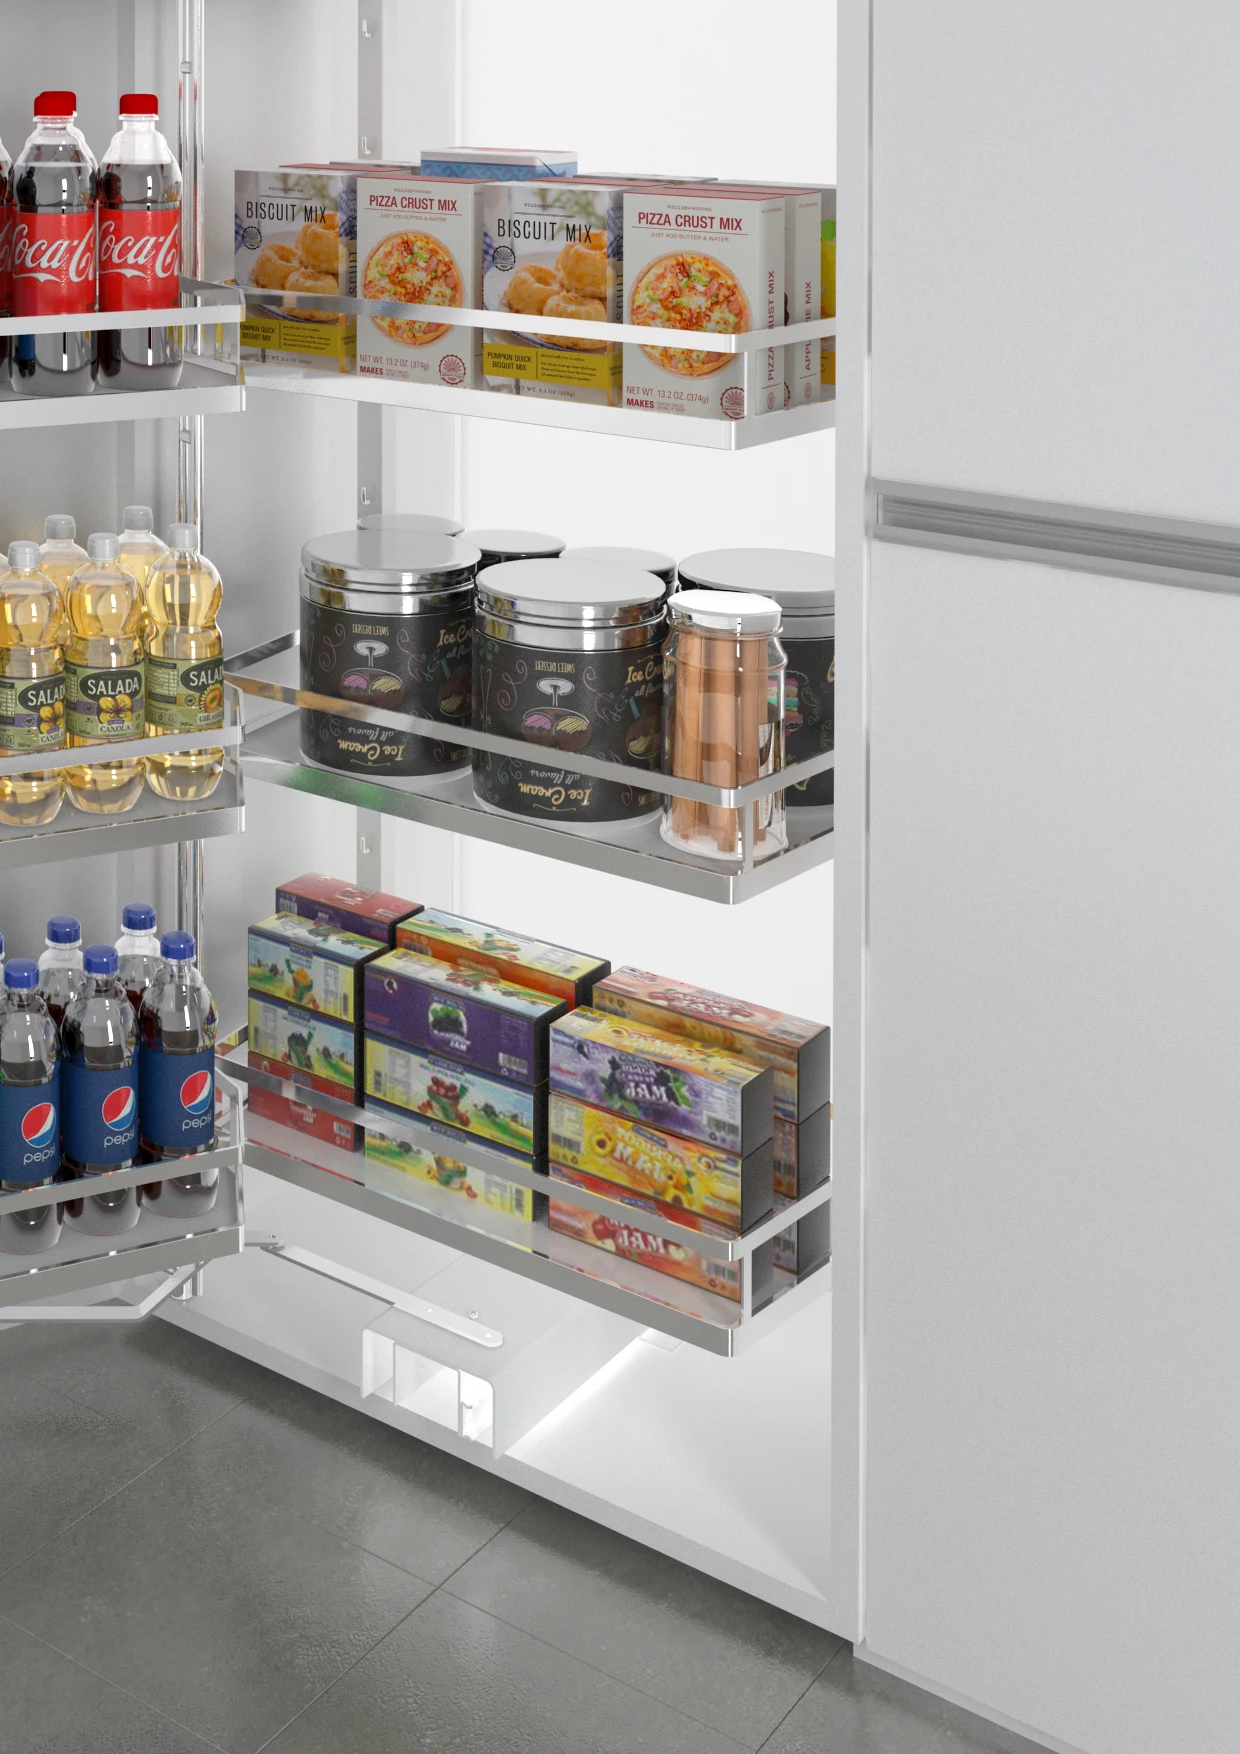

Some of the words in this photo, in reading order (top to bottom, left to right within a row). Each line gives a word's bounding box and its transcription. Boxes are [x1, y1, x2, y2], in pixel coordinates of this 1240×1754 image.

[369, 194, 397, 207] PIZZA
[400, 196, 434, 210] CRUST
[438, 199, 457, 212] MIX
[246, 201, 297, 222] BISCUIT
[304, 205, 327, 224] MIX
[638, 212, 671, 226] PIZZA
[675, 214, 715, 229] CRUST
[719, 218, 743, 231] MIX
[497, 218, 557, 241] BISCUIT
[565, 223, 592, 244] MIX
[261, 326, 276, 334] QUICK
[360, 354, 371, 363] NET
[373, 356, 384, 364] WT.
[386, 357, 398, 366] 13.2
[411, 360, 429, 371] (374g)
[487, 352, 513, 361] PUMPKIN
[514, 355, 532, 363] QUICK
[492, 361, 514, 370] BISQUIT
[360, 366, 384, 375] MAKES
[626, 386, 640, 395] NET
[642, 387, 655, 397] WT.
[657, 389, 672, 399] 13.2
[686, 393, 709, 404] (374g)
[626, 398, 655, 409] MAKES
[372, 625, 390, 636] SWEET
[437, 629, 456, 647] Ice
[535, 660, 557, 672] DESSERT
[557, 662, 575, 673] SWEET
[190, 667, 223, 686] SALAD
[625, 666, 644, 685] Ice
[28, 682, 65, 706] SALAD
[87, 677, 140, 695] SALADA
[634, 683, 645, 697] all
[199, 711, 223, 723] GIRASSO
[100, 724, 131, 733] CANOLA
[348, 727, 380, 741] flavors
[380, 730, 394, 742] all
[337, 738, 381, 760] Cream
[382, 744, 407, 761] Ice
[530, 769, 565, 784] flavors
[565, 773, 580, 785] all
[518, 782, 566, 806] Cream
[567, 787, 593, 806] Ice
[626, 1082, 668, 1102] JAM
[182, 1110, 212, 1132] pepsi
[103, 1126, 135, 1148] pepsi
[23, 1143, 56, 1165] pepsi
[619, 1229, 665, 1255] JAM
